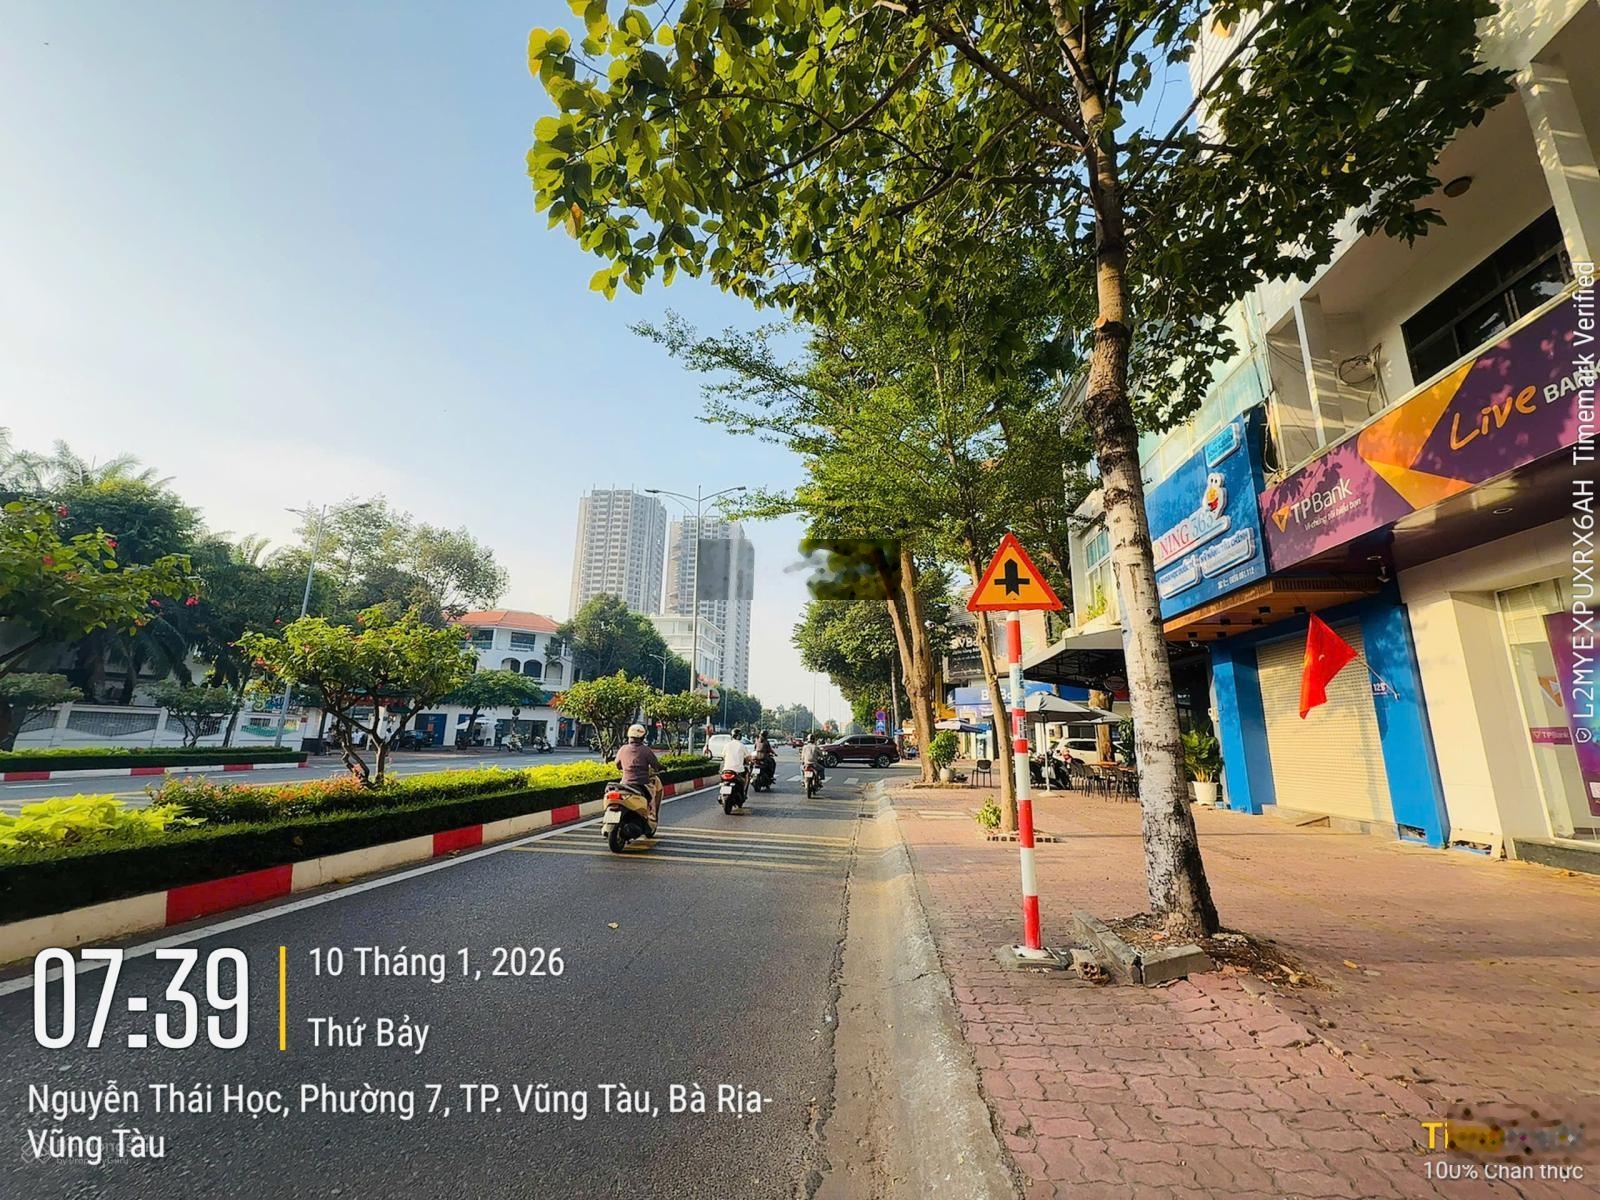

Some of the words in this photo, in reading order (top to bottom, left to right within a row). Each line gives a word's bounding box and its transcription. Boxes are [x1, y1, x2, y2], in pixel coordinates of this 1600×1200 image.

[1449, 385, 1537, 451] Live
[1543, 359, 1600, 404] BAN
[1291, 478, 1352, 523] TPBank
